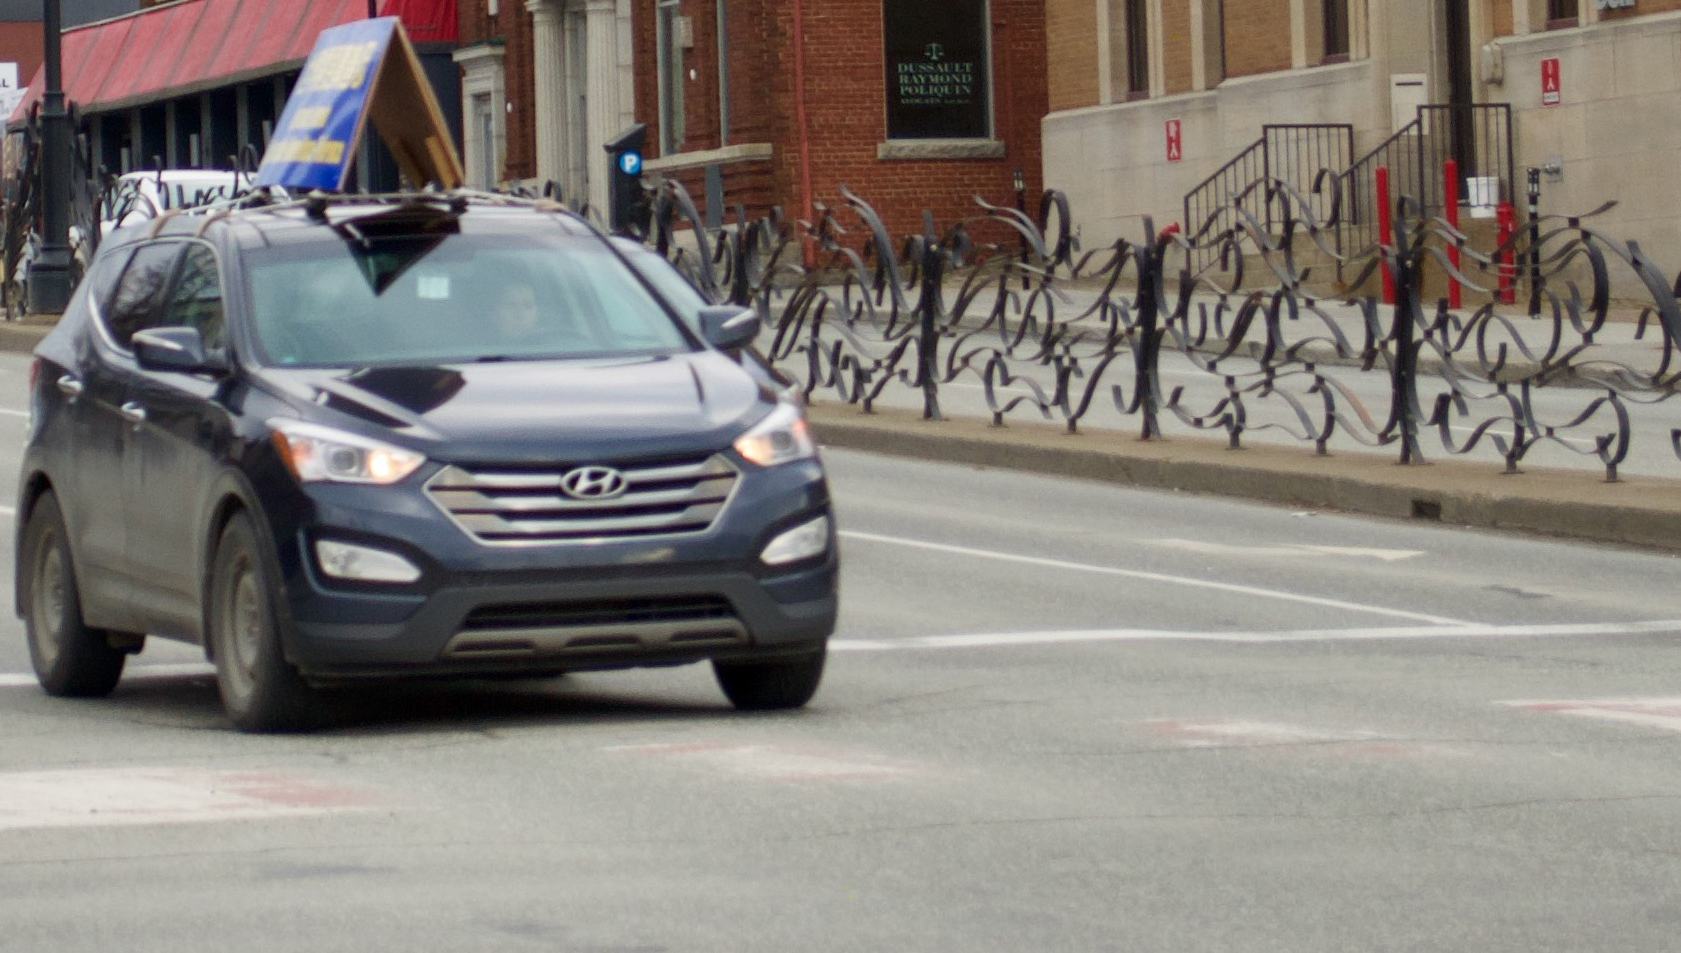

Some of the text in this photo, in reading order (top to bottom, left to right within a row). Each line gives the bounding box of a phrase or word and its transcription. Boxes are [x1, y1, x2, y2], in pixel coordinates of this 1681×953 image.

[897, 63, 973, 73] DUSSAULT
[899, 74, 972, 84] RAYMOND
[900, 85, 971, 97] POLIQUIN
[625, 154, 638, 173] P
